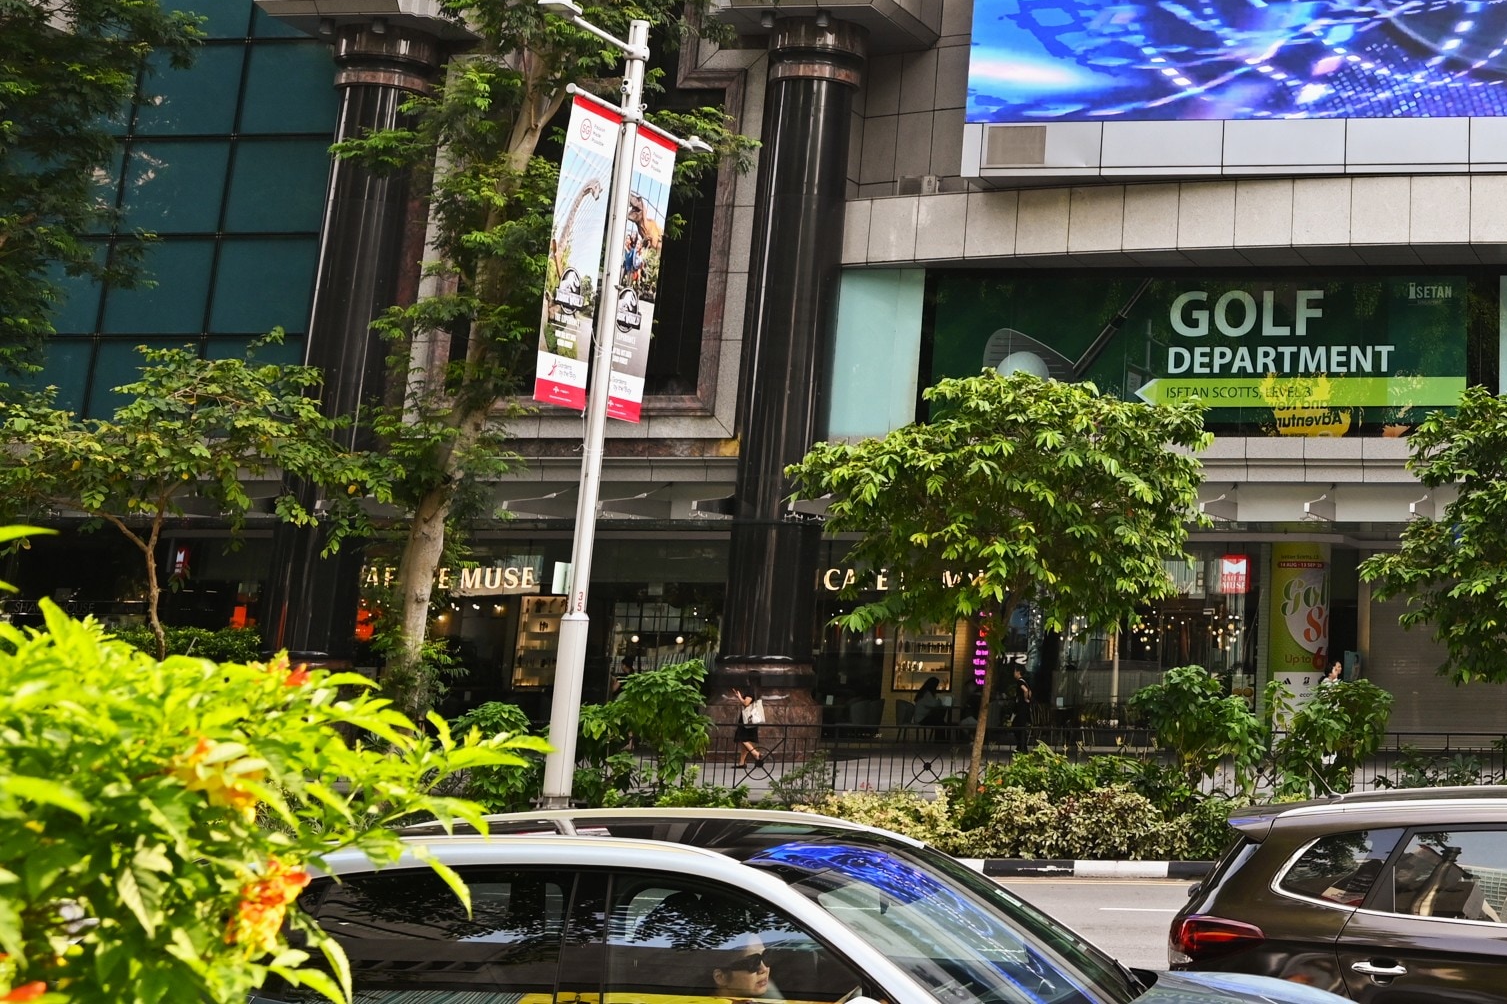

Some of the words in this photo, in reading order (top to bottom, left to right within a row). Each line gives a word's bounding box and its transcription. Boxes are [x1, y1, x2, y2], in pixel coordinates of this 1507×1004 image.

[1407, 282, 1453, 300] ISETAN
[1169, 289, 1325, 338] GOLF
[1166, 344, 1396, 375] DEPARTMENT
[1166, 386, 1209, 399] ISETAN
[1212, 386, 1260, 399] SCOTTS,
[460, 566, 534, 589] MUSE
